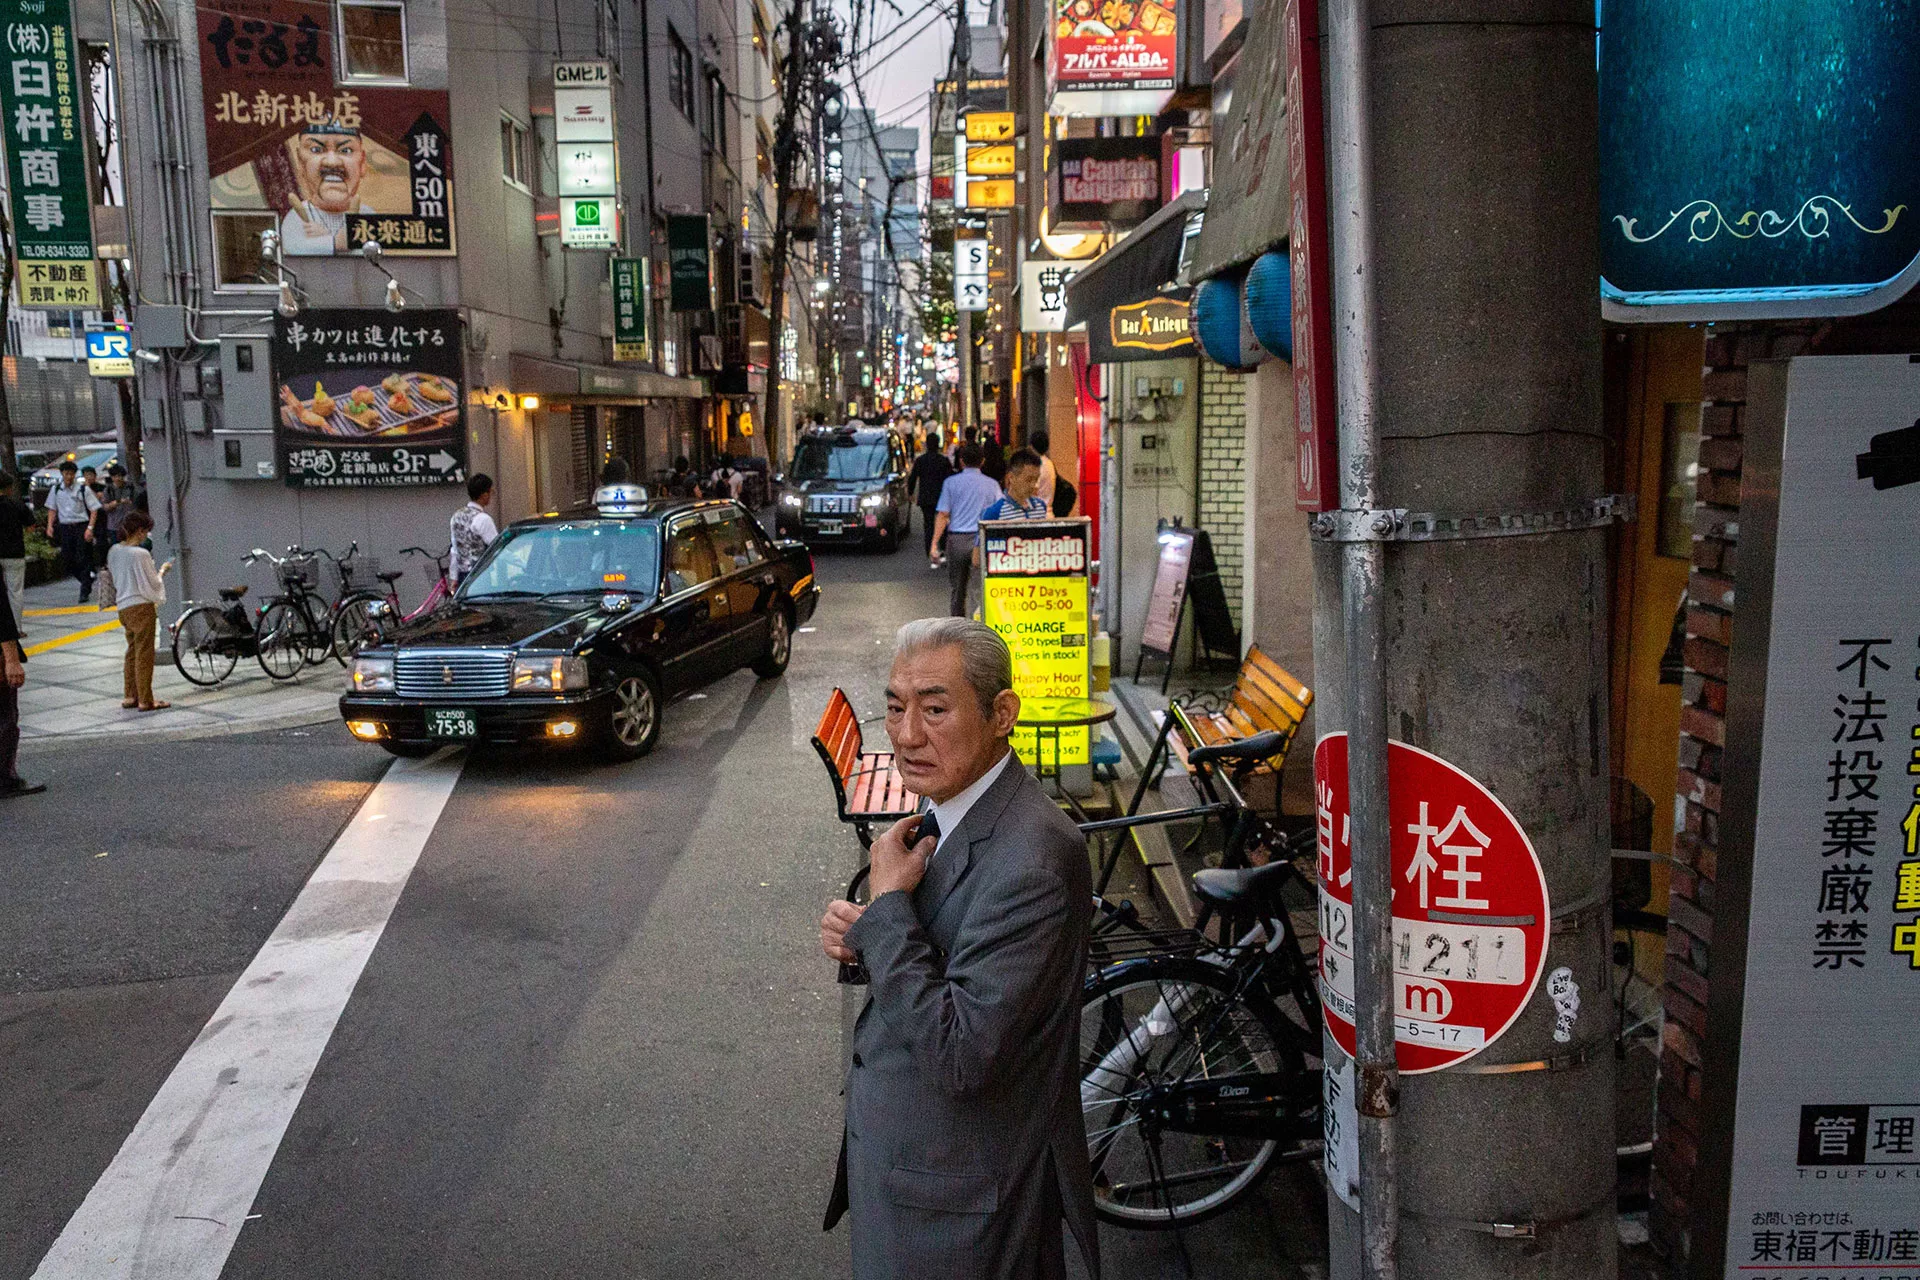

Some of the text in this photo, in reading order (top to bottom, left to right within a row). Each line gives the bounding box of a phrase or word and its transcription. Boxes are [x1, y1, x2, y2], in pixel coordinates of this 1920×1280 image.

[20, 0, 45, 15] Syoji
[206, 14, 325, 69] だるま
[556, 65, 607, 82] GMビル
[214, 89, 361, 128] 北新地店
[413, 132, 444, 218] 東へ50m
[970, 247, 982, 263] S
[27, 264, 87, 282] 不動産
[29, 286, 89, 302] 売買・仲介
[1121, 315, 1188, 334] Bar Arlequ
[90, 335, 128, 357] JR
[287, 321, 445, 352] 串カツは進化する
[340, 451, 371, 462] だるま
[392, 449, 427, 473] 3F
[342, 462, 390, 474] 北新地店
[987, 536, 1083, 555] BAR Captain
[988, 551, 1084, 573] Kangaroo
[990, 585, 1068, 598] OPEN 7 Days
[994, 622, 1065, 633] NO CHARGE
[1022, 638, 1034, 646] 50
[1036, 637, 1060, 648] types
[1015, 650, 1080, 660] Beers in stock!
[1013, 672, 1082, 683] Happy Hour
[436, 719, 475, 735] 75-98
[1812, 638, 1893, 970] 不法投棄厳禁
[1316, 780, 1492, 909] 消栓
[1405, 983, 1444, 1015] m
[1813, 1116, 1914, 1156] 管理
[1751, 1228, 1919, 1262] 東福不動産
